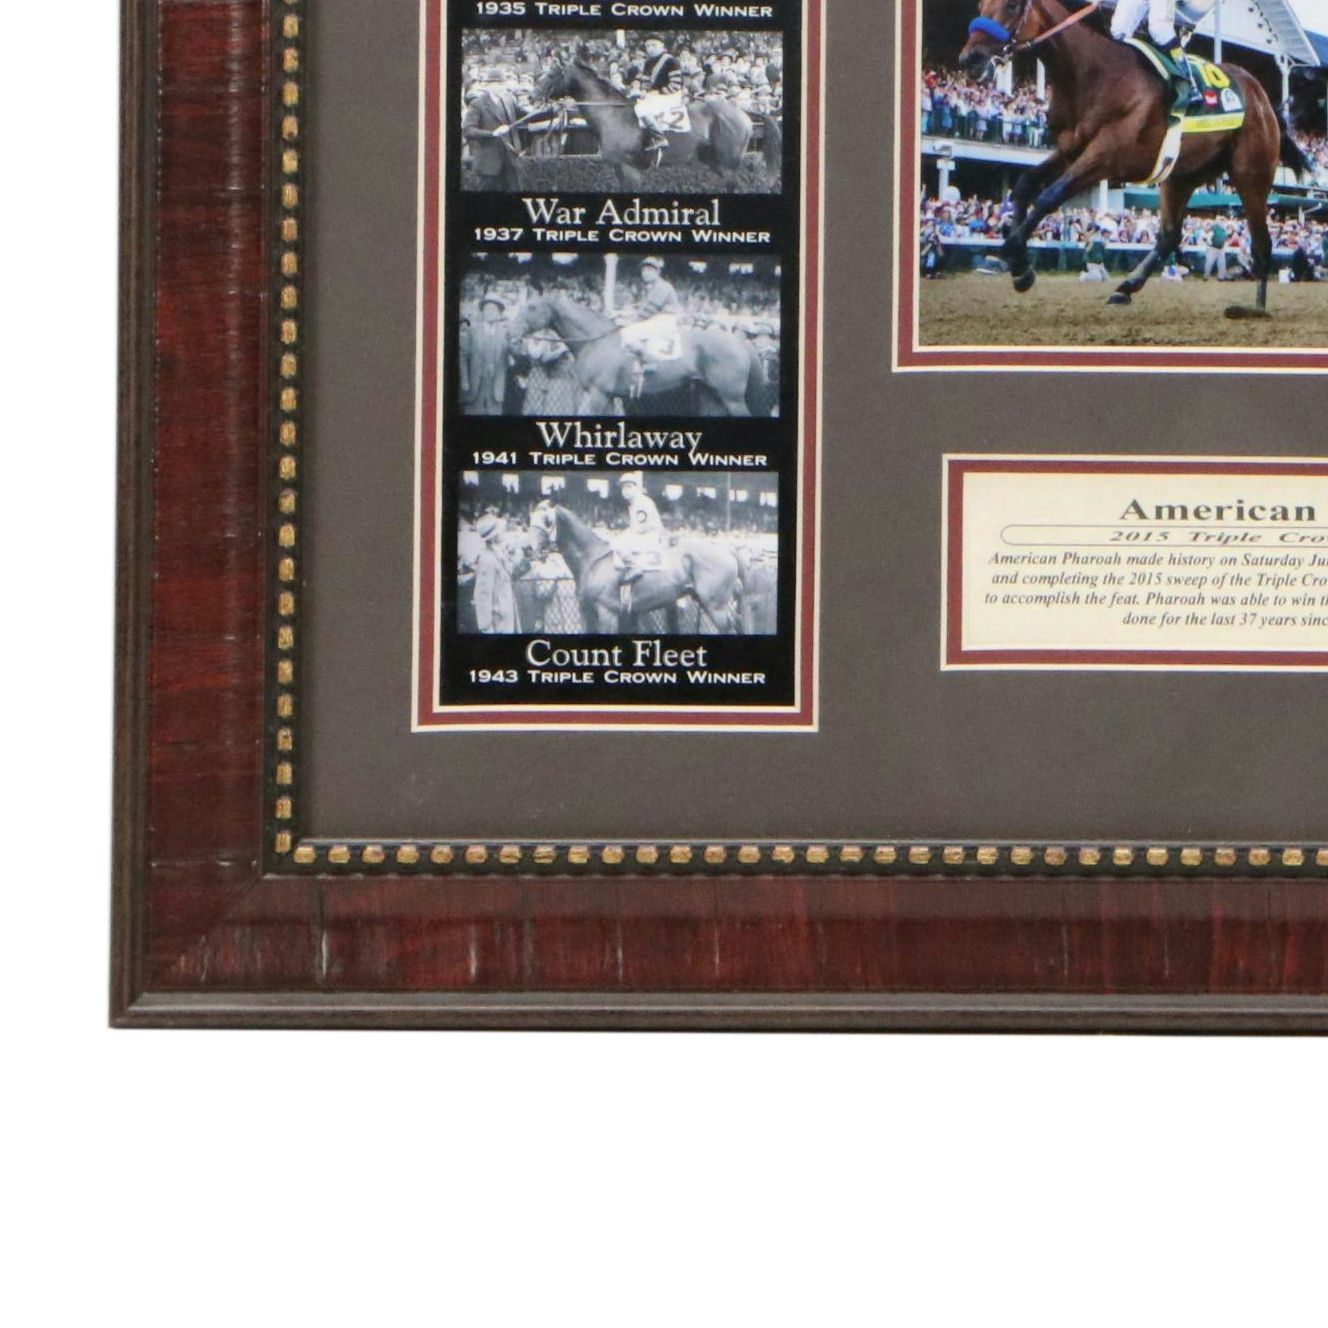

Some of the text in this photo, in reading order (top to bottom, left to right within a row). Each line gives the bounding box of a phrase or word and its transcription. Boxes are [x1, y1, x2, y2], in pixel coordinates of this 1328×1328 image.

[476, 1, 526, 15] 1935
[521, 197, 720, 226] War Admiral
[474, 227, 523, 241] 1937
[535, 421, 702, 456] Whirlaway
[473, 451, 516, 464] 1941
[1120, 499, 1315, 521] American
[1110, 532, 1169, 542] 2015
[1191, 531, 1261, 545] Triple
[988, 551, 1057, 565] American
[1061, 551, 1121, 565] Pharoah
[1126, 552, 1164, 565] made
[1167, 552, 1215, 569] history
[1219, 556, 1237, 566] on
[1241, 553, 1304, 570] Saturday
[984, 593, 998, 604] to
[1001, 591, 1080, 608] accomplish
[1084, 591, 1107, 604] the
[1107, 591, 1139, 608] feat.
[1145, 591, 1205, 605] Pharoah
[1210, 596, 1235, 606] was
[1240, 592, 1269, 606] able
[1273, 595, 1287, 606] to
[1291, 593, 1316, 606] win
[1122, 612, 1157, 625] done
[1158, 611, 1181, 628] for
[1184, 612, 1207, 625] the
[1210, 612, 1236, 625] last
[1239, 612, 1257, 625] 37
[1258, 616, 1296, 629] years
[526, 639, 707, 667] Count Fleet
[469, 669, 518, 683] 1943
